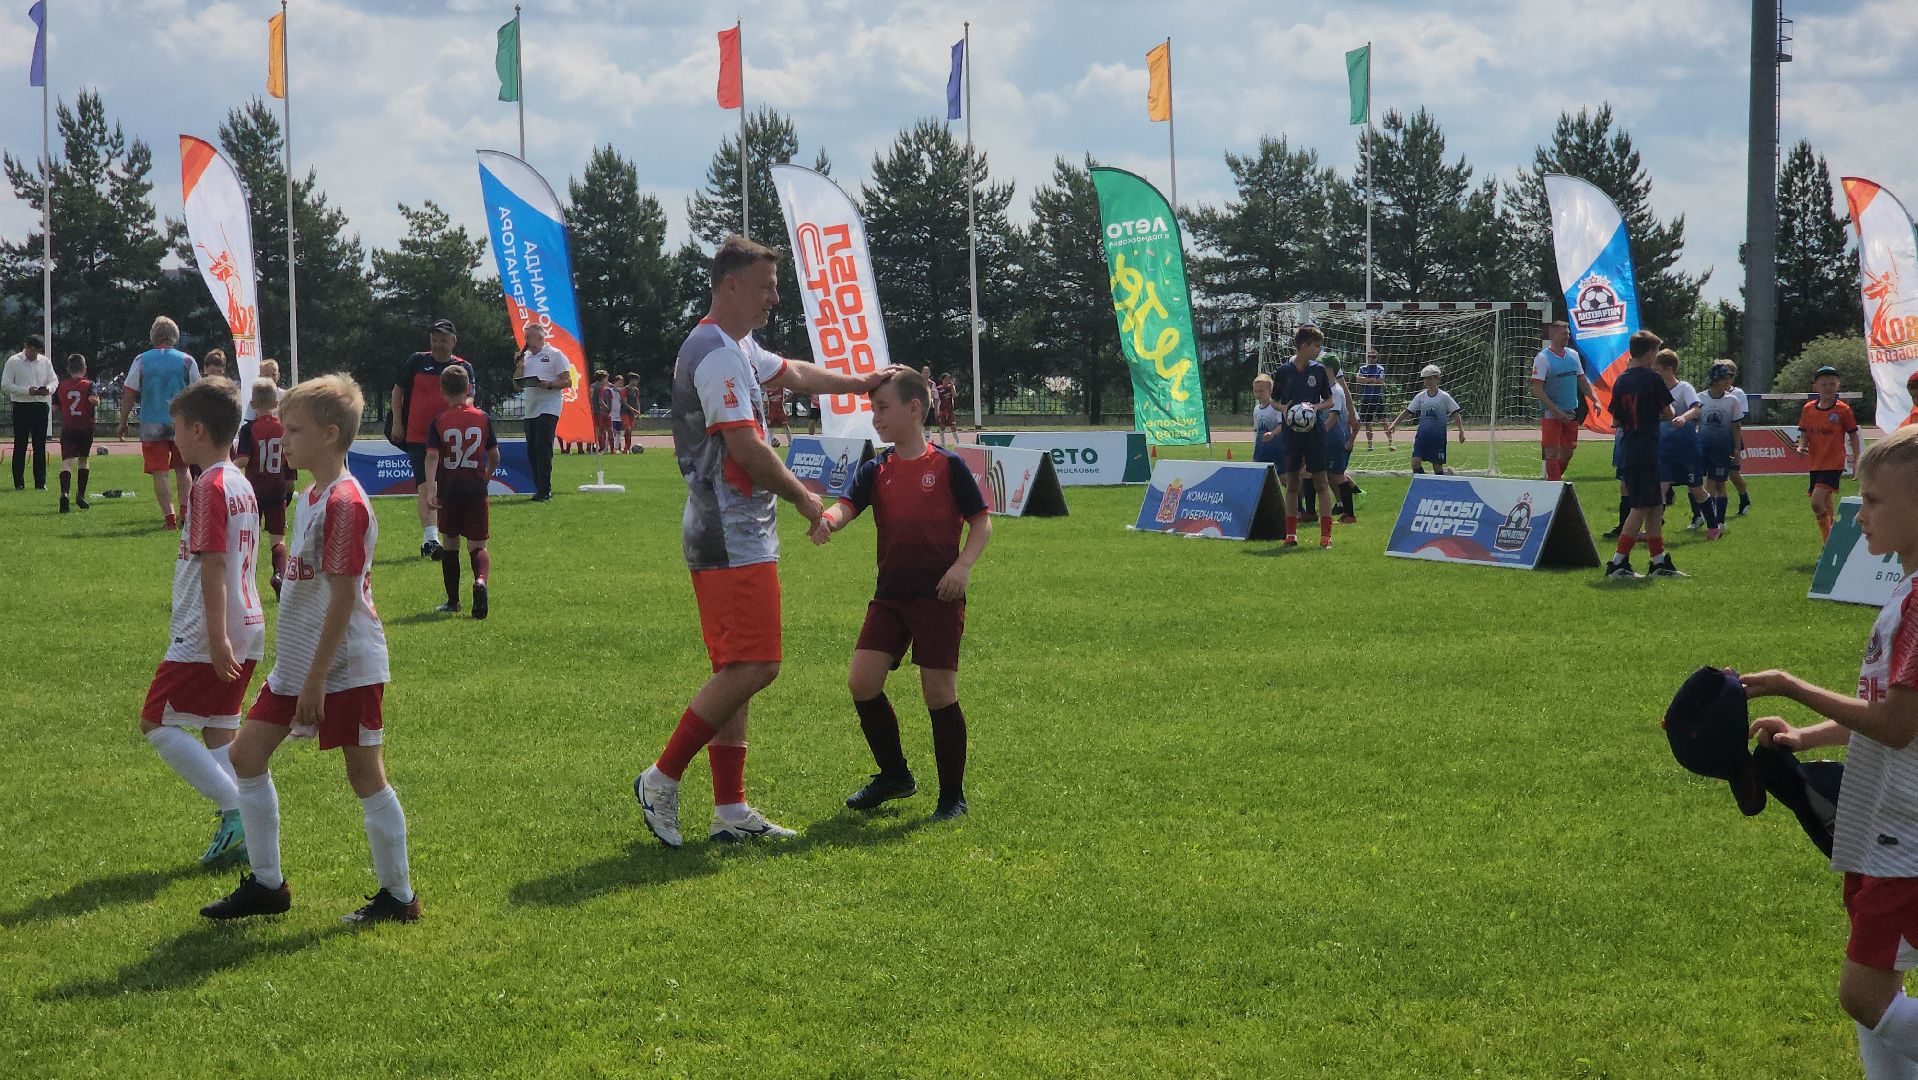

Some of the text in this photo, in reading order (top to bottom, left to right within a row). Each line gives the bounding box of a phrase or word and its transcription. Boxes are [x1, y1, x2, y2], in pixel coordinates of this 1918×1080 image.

[67, 390, 82, 416] 2
[258, 437, 283, 474] 18
[443, 426, 482, 470] 32
[1186, 490, 1224, 505] КОМАНДА
[1415, 498, 1485, 519] МОСОБЛ
[1180, 508, 1233, 523] ГУБЕРНАТОРА
